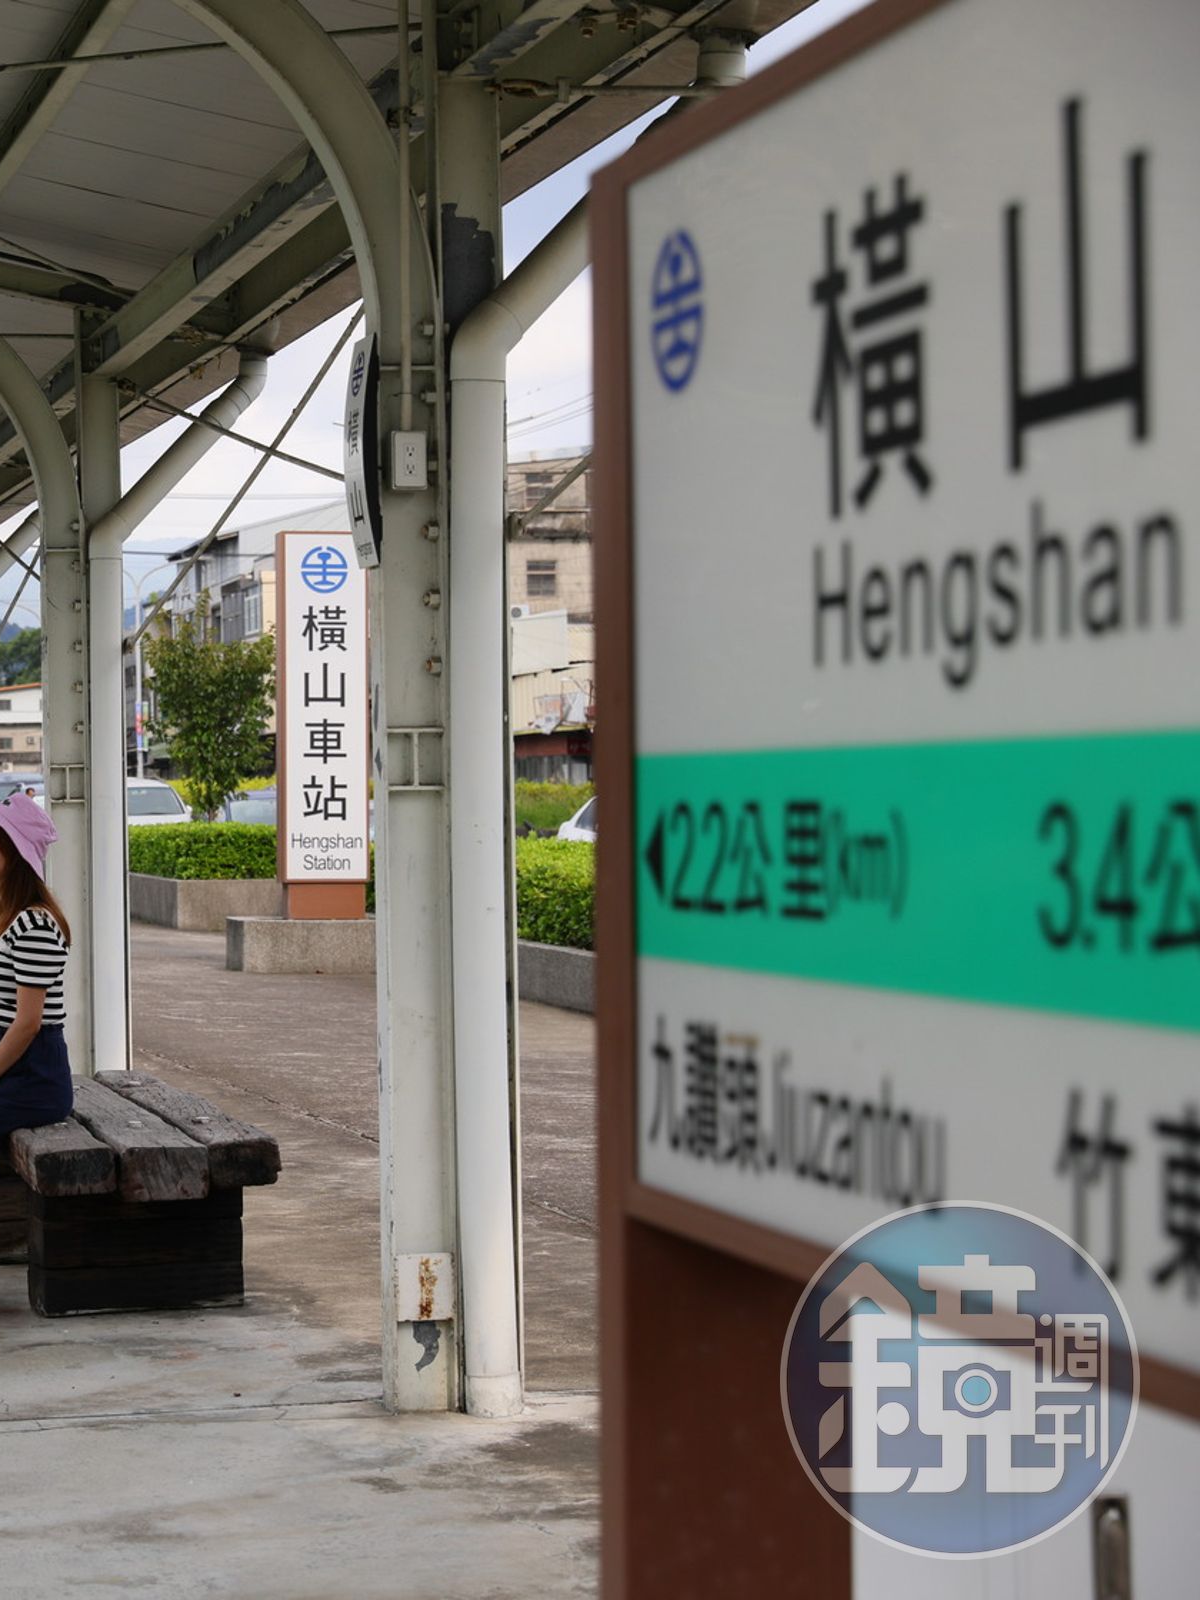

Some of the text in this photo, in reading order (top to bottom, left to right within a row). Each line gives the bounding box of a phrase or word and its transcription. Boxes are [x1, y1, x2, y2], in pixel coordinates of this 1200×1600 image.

[811, 94, 1151, 521] 橫山
[811, 500, 1184, 690] Hengshan
[302, 605, 347, 821] 橫山車站
[291, 832, 363, 853] Hengshan
[303, 854, 351, 871] Station
